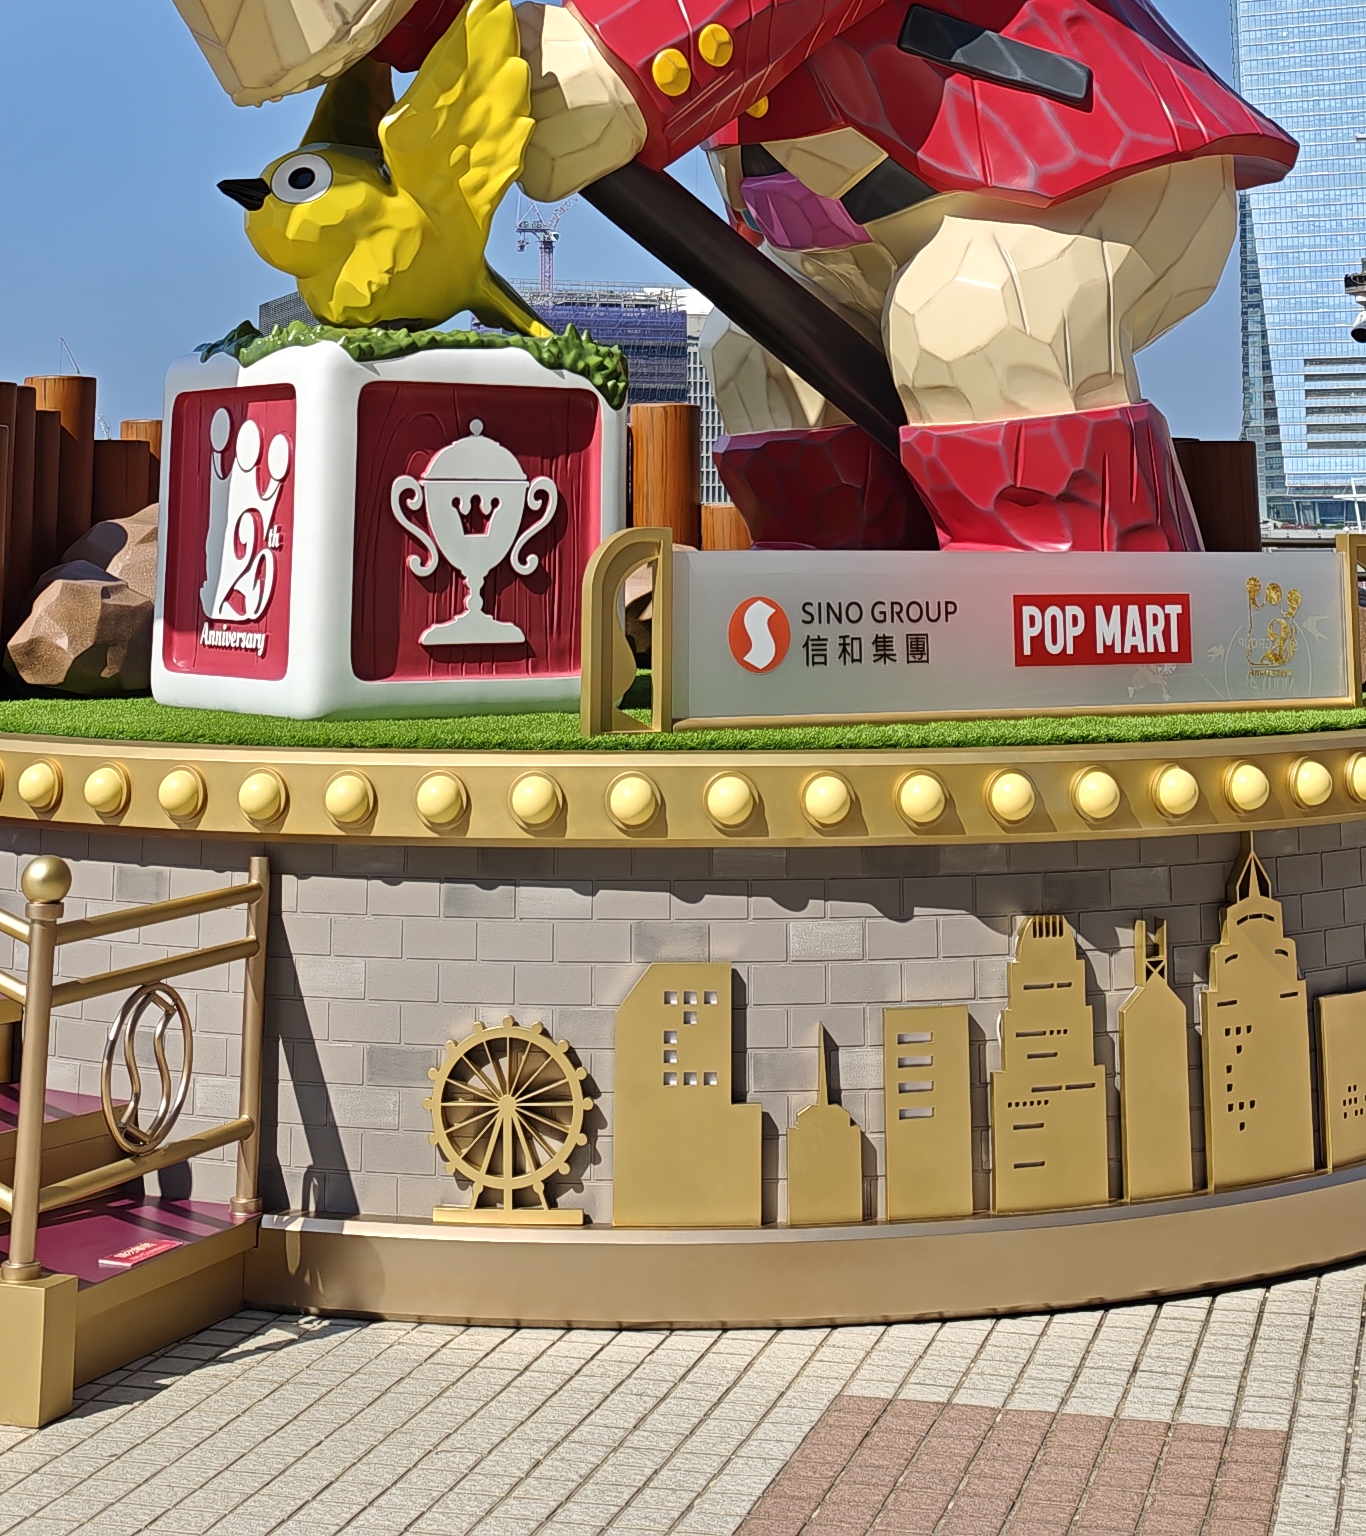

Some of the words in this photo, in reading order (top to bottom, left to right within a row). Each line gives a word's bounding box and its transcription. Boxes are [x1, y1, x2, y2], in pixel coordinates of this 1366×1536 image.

[801, 601, 863, 624] SINO
[870, 600, 958, 624] GROUP
[200, 622, 266, 656] Anniversary
[1021, 605, 1085, 656] POP
[1094, 604, 1183, 654] MART
[801, 633, 930, 667] 信和集團
